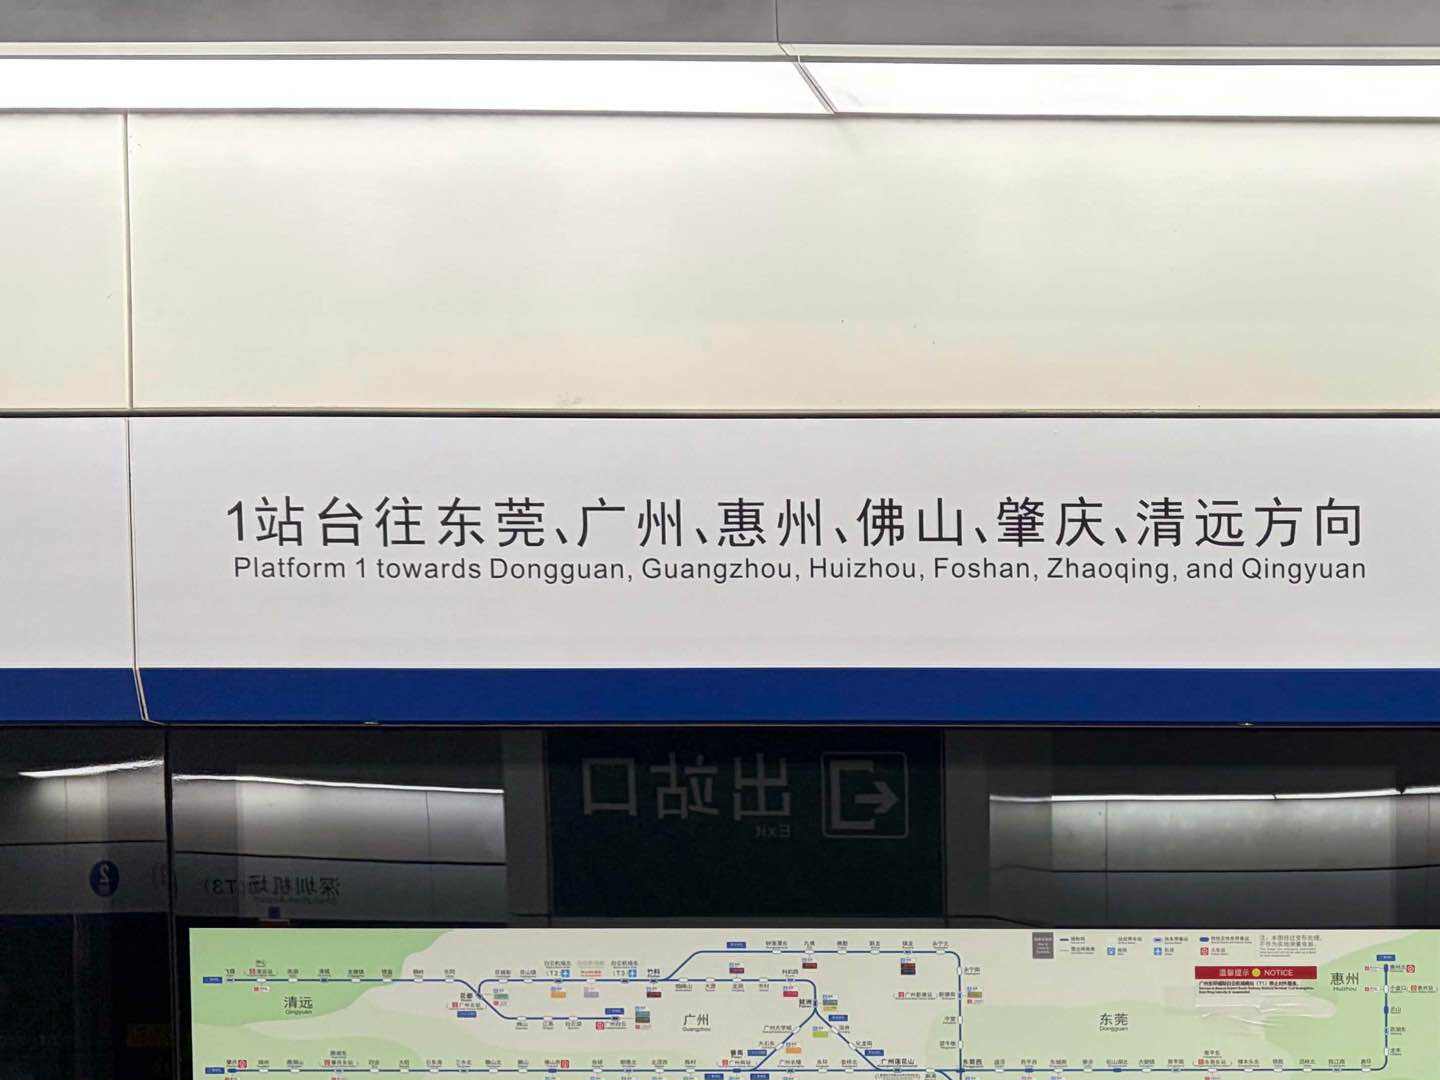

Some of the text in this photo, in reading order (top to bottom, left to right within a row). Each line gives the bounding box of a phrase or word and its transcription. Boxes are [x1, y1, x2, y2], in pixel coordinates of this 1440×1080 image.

[228, 496, 1360, 547] 1站台往东莞、广州、惠州、佛山、肇庆、清远方向
[235, 557, 1364, 584] Platform 1 towards Dongguan, Guangzhou, Huizhou, Foshan, Zhaoqing, and Qingyuan
[1331, 972, 1359, 985] 惠州
[284, 996, 313, 1010] 清远
[683, 1014, 710, 1026] 广州
[1100, 1013, 1128, 1026] 东莞
